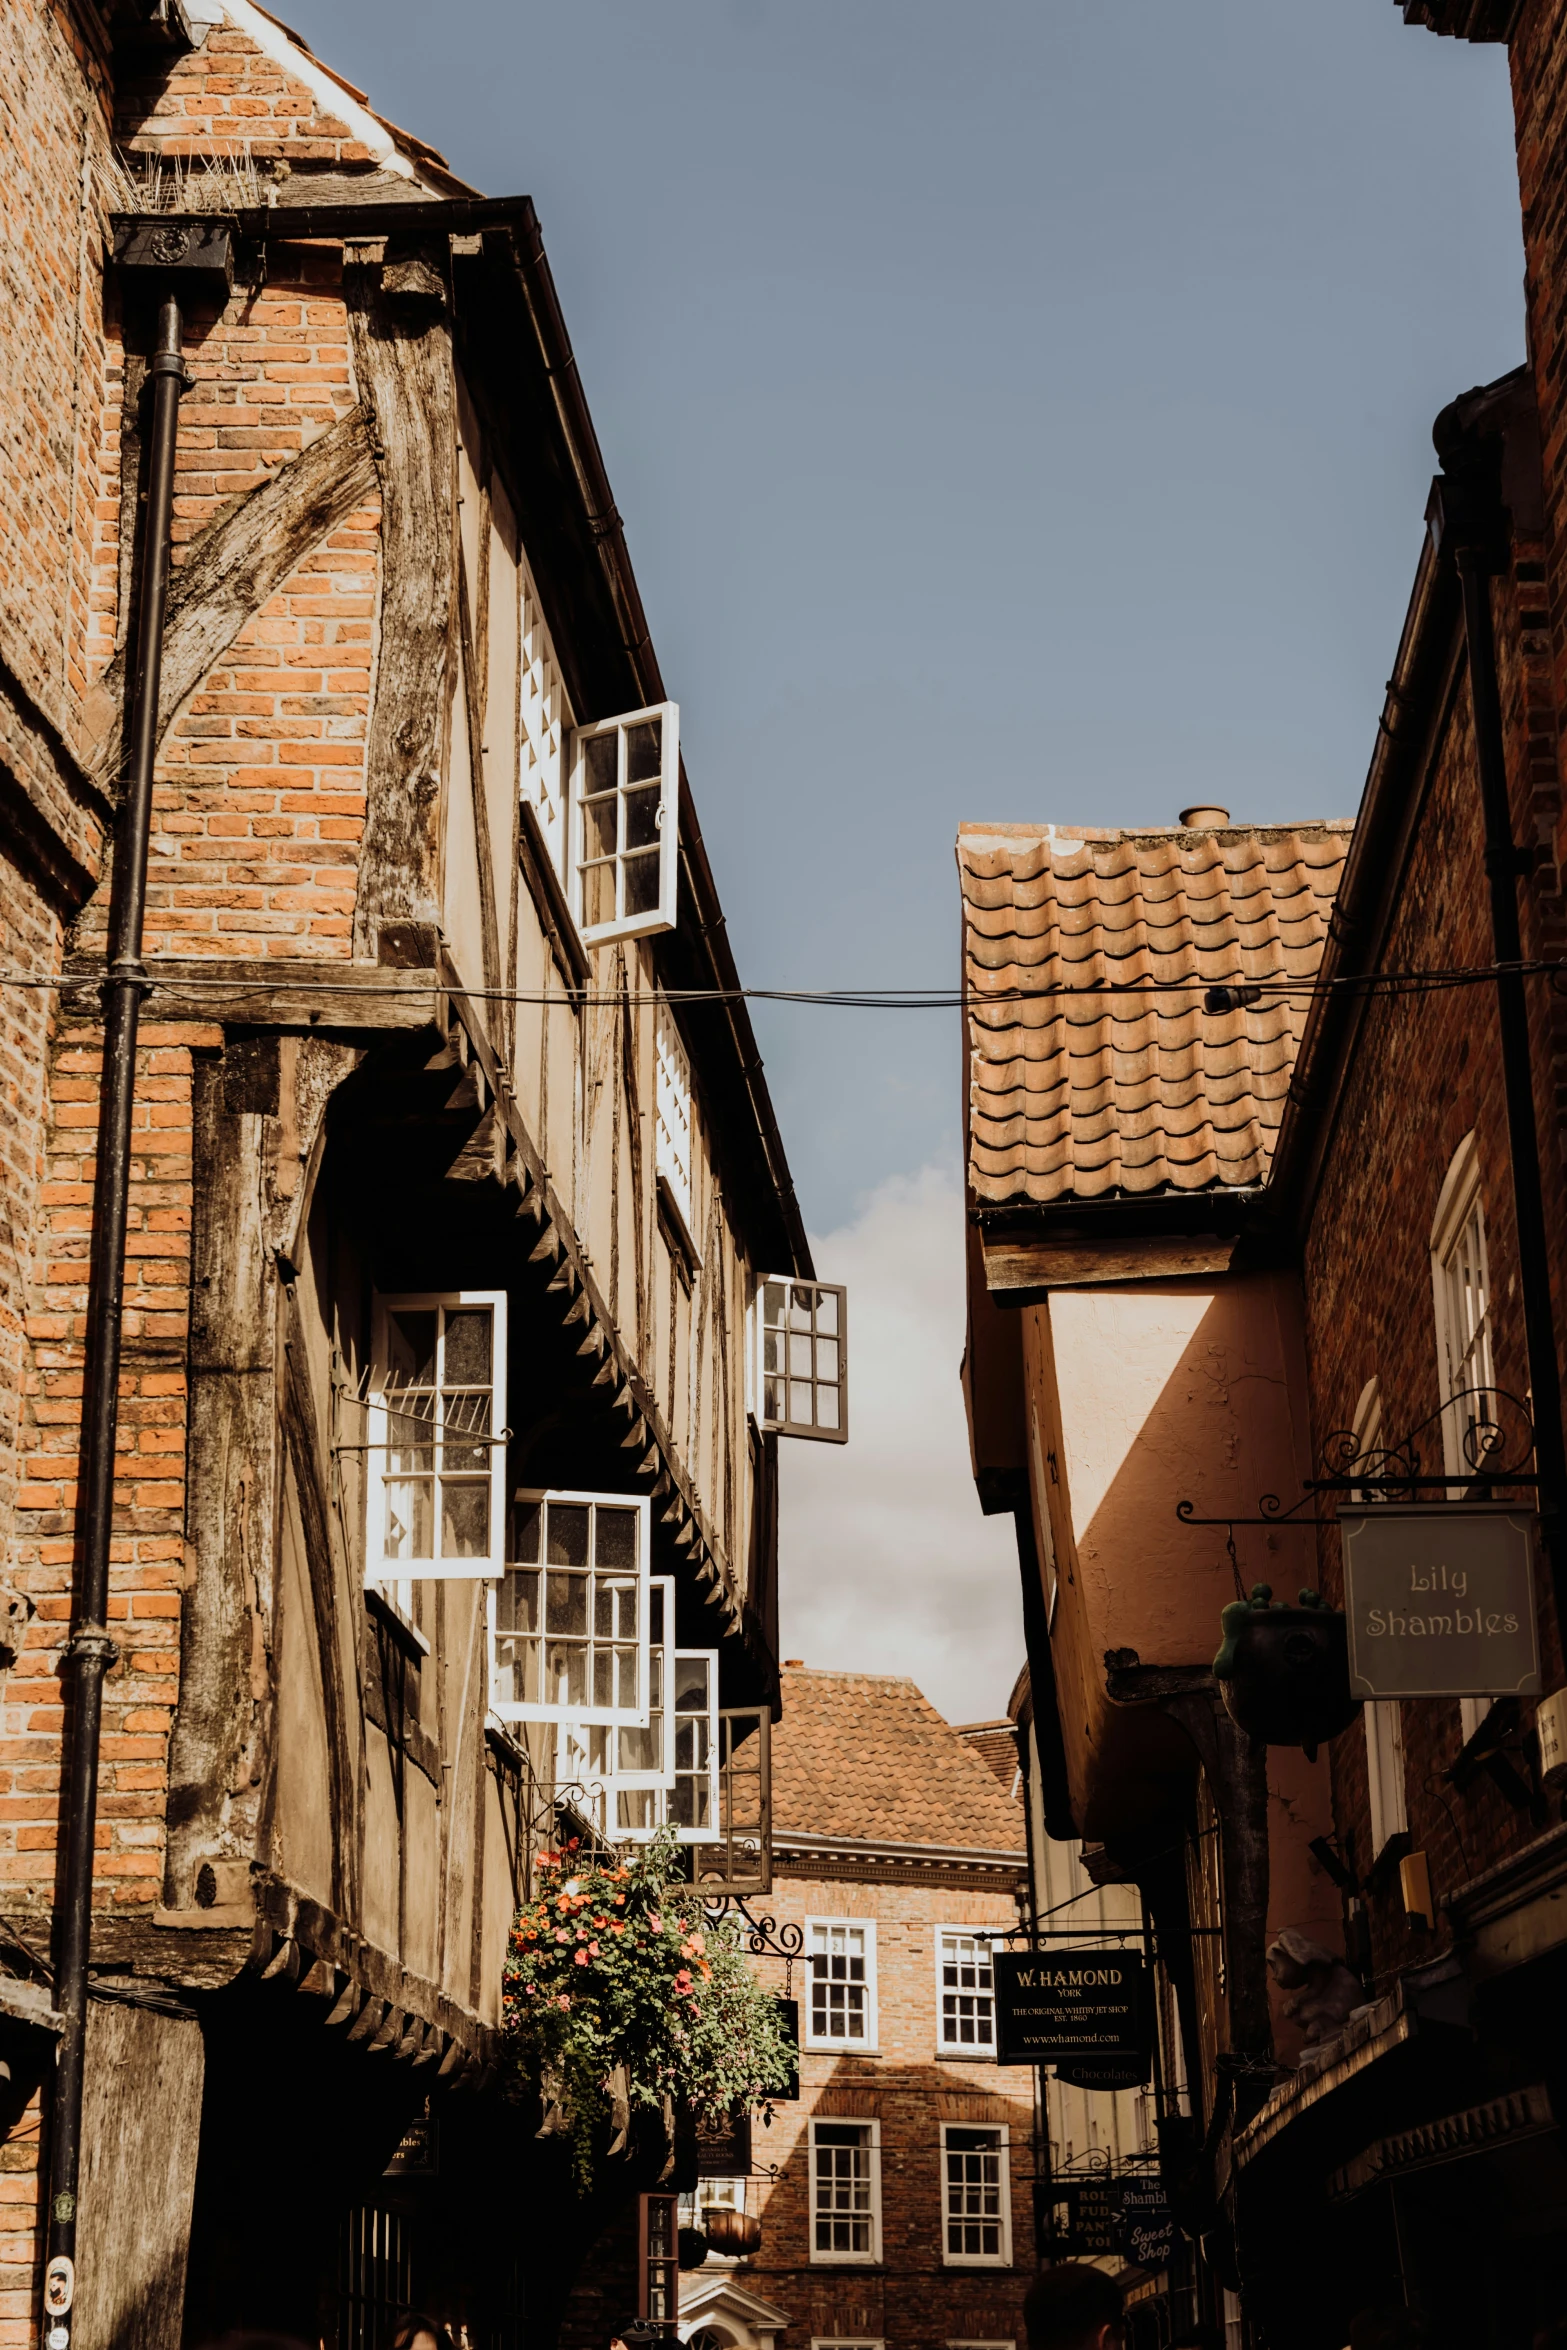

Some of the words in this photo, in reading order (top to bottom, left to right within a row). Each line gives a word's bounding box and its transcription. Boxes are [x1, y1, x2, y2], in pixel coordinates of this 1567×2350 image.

[1409, 1564, 1468, 1597] Lily
[1365, 1606, 1520, 1637] Shambles
[1016, 1968, 1037, 1988] W.
[1040, 1969, 1123, 1987] HAMOND
[1057, 1989, 1082, 1998] YORK
[1012, 2008, 1027, 2016] THE
[1027, 2007, 1064, 2016] ORIGINAL
[1065, 2006, 1095, 2015] WHITBY
[1095, 2006, 1108, 2016] JET
[1108, 2005, 1129, 2014] SHOP
[1054, 2015, 1068, 2023] EST.
[1022, 2033, 1120, 2044] www.whamond.com
[1071, 2067, 1138, 2080] Chocolates
[1139, 2179, 1161, 2190] The
[1130, 2221, 1174, 2246] Sweet
[1137, 2242, 1171, 2263] Shop
